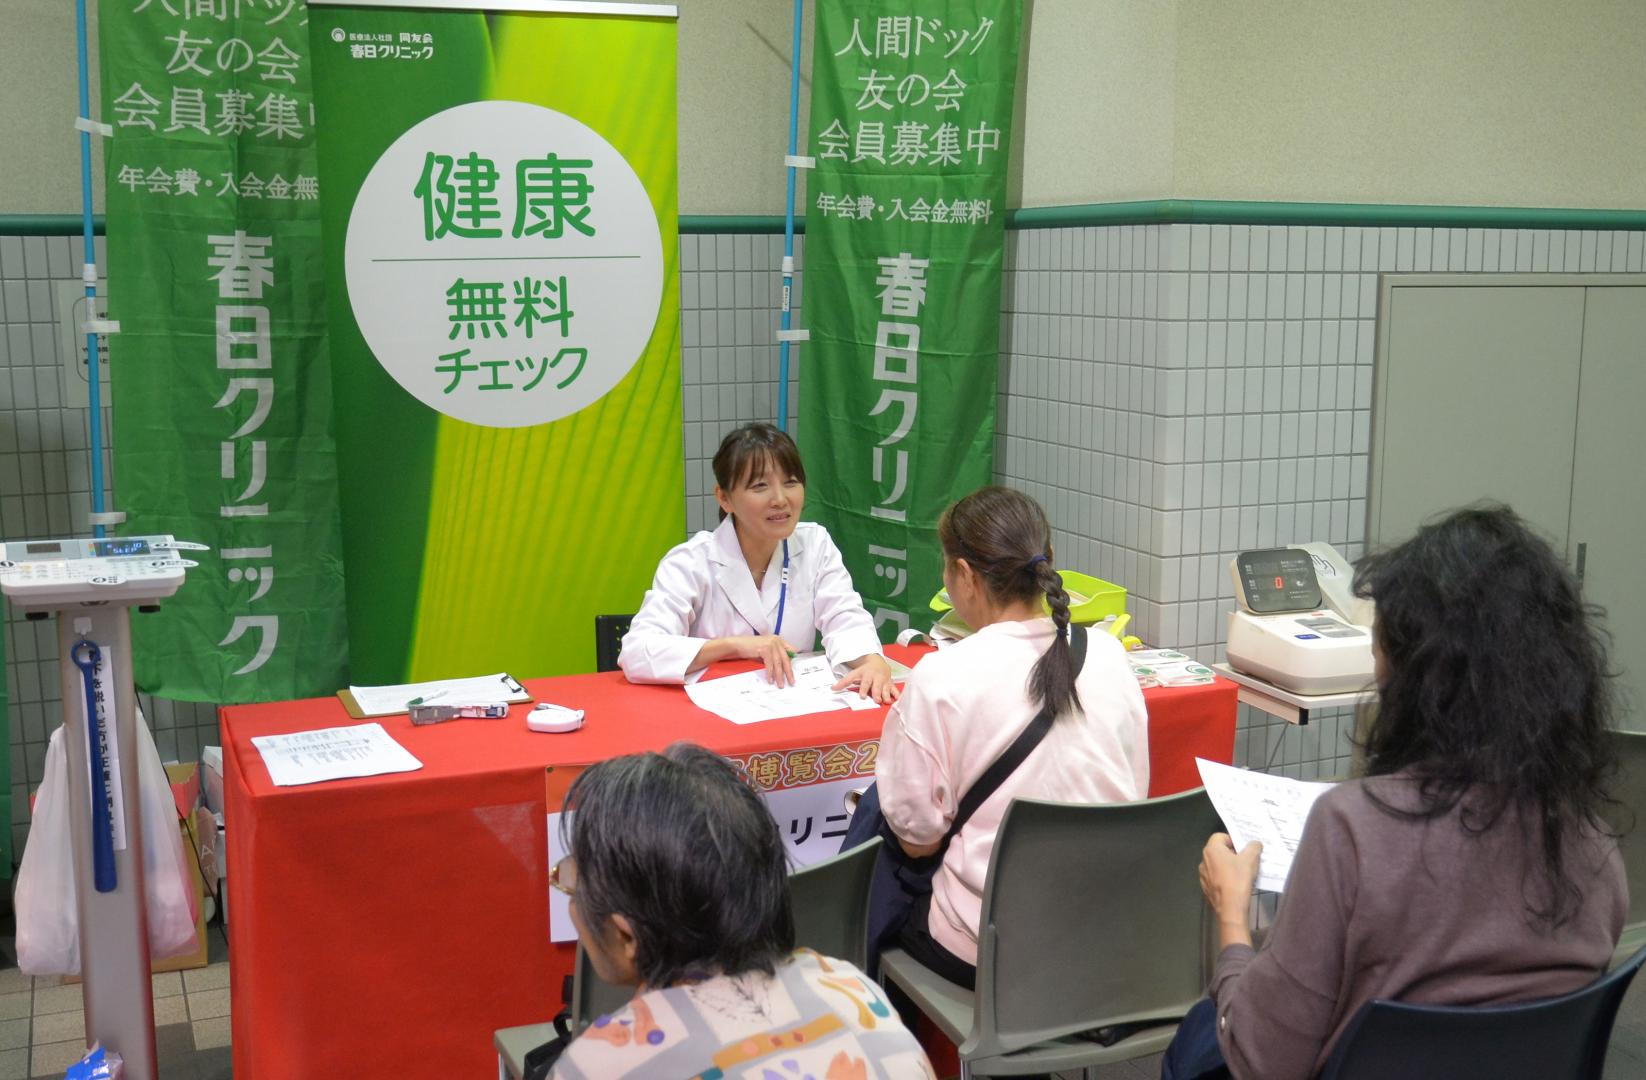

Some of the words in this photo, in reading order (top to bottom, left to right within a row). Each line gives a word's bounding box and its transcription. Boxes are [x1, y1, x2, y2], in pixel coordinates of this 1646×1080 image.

[164, 29, 301, 84] 友の会
[350, 44, 433, 59] 春日クリニック
[400, 33, 433, 43] 同友会
[834, 16, 994, 59] 人間ドック
[113, 82, 315, 140] 会員募集
[856, 69, 967, 111] 友の会
[818, 118, 1000, 167] 会員募集中
[414, 152, 596, 241] 健康
[816, 192, 994, 225] 年会費・入会金無料
[446, 276, 575, 341] 無料
[435, 348, 588, 394] チェック
[207, 229, 279, 676] 春日クリニック
[730, 743, 879, 789] 博覧会2
